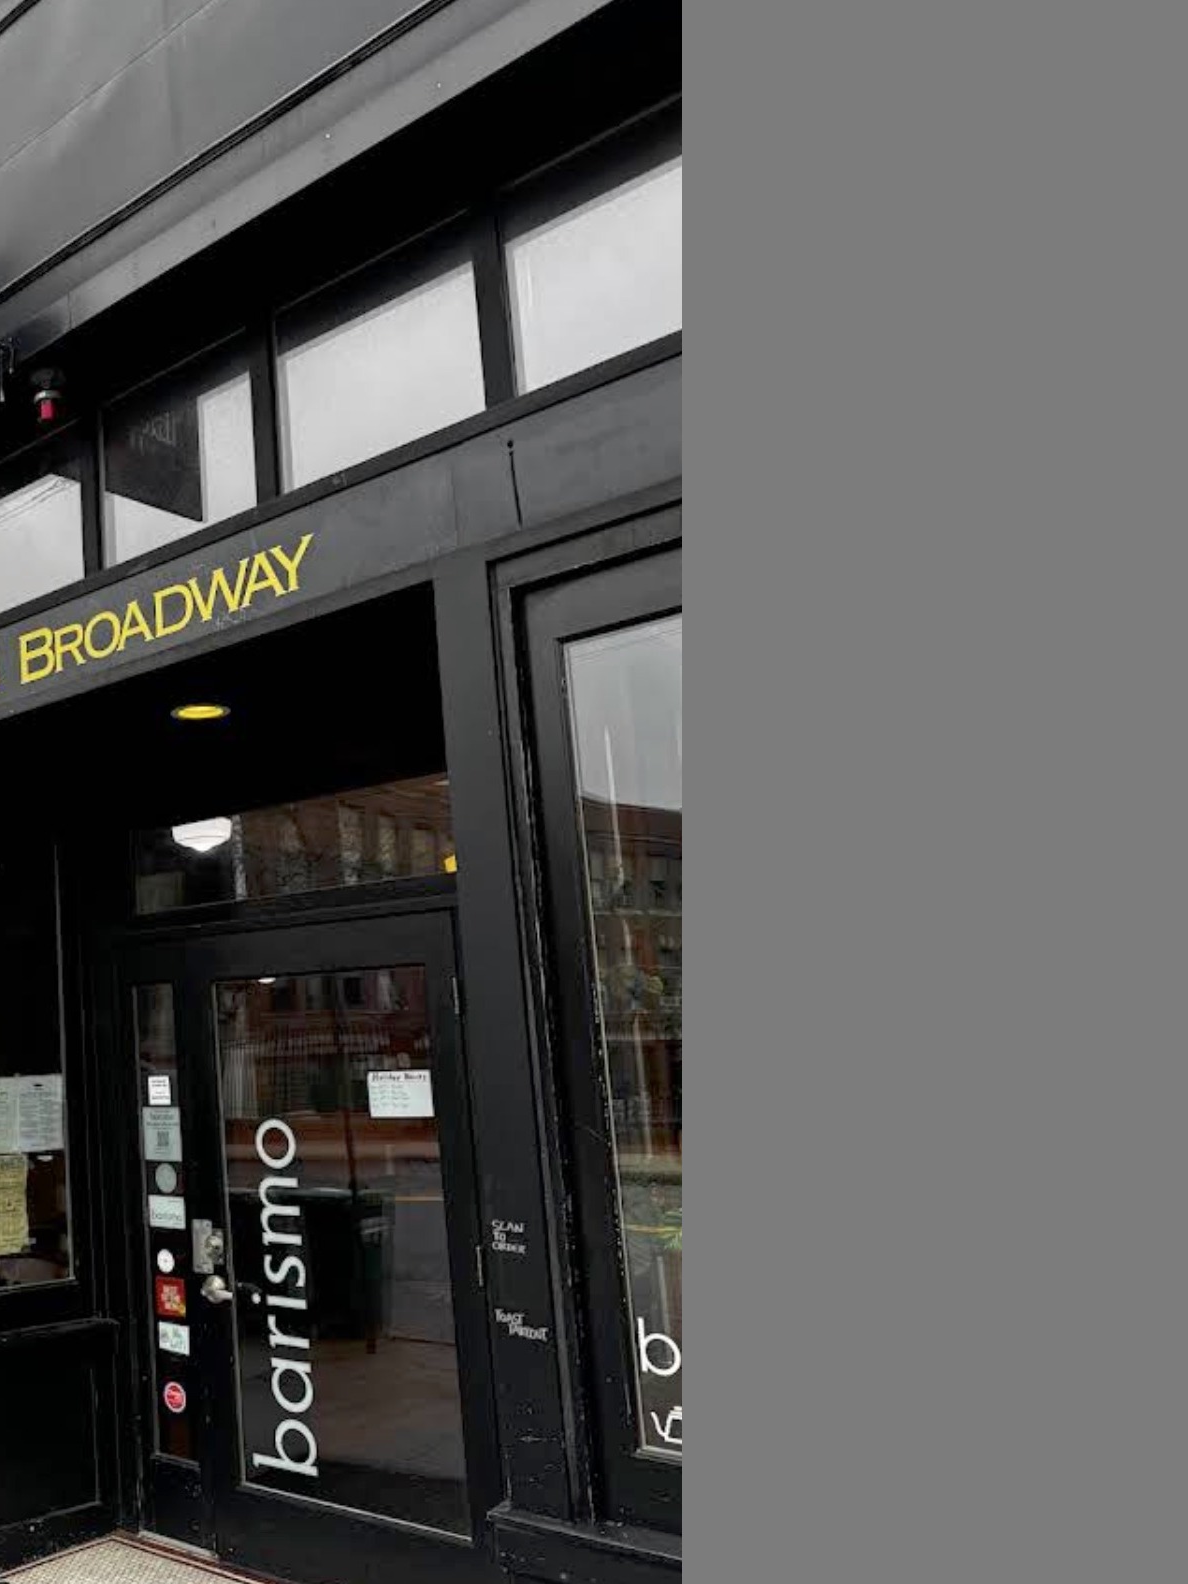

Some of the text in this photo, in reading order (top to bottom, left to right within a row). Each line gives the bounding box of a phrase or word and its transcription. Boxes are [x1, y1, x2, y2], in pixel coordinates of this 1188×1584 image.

[18, 533, 313, 685] BROADWAY
[492, 1219, 524, 1233] SCAN
[493, 1232, 507, 1241] TO
[252, 1117, 319, 1477] barismo
